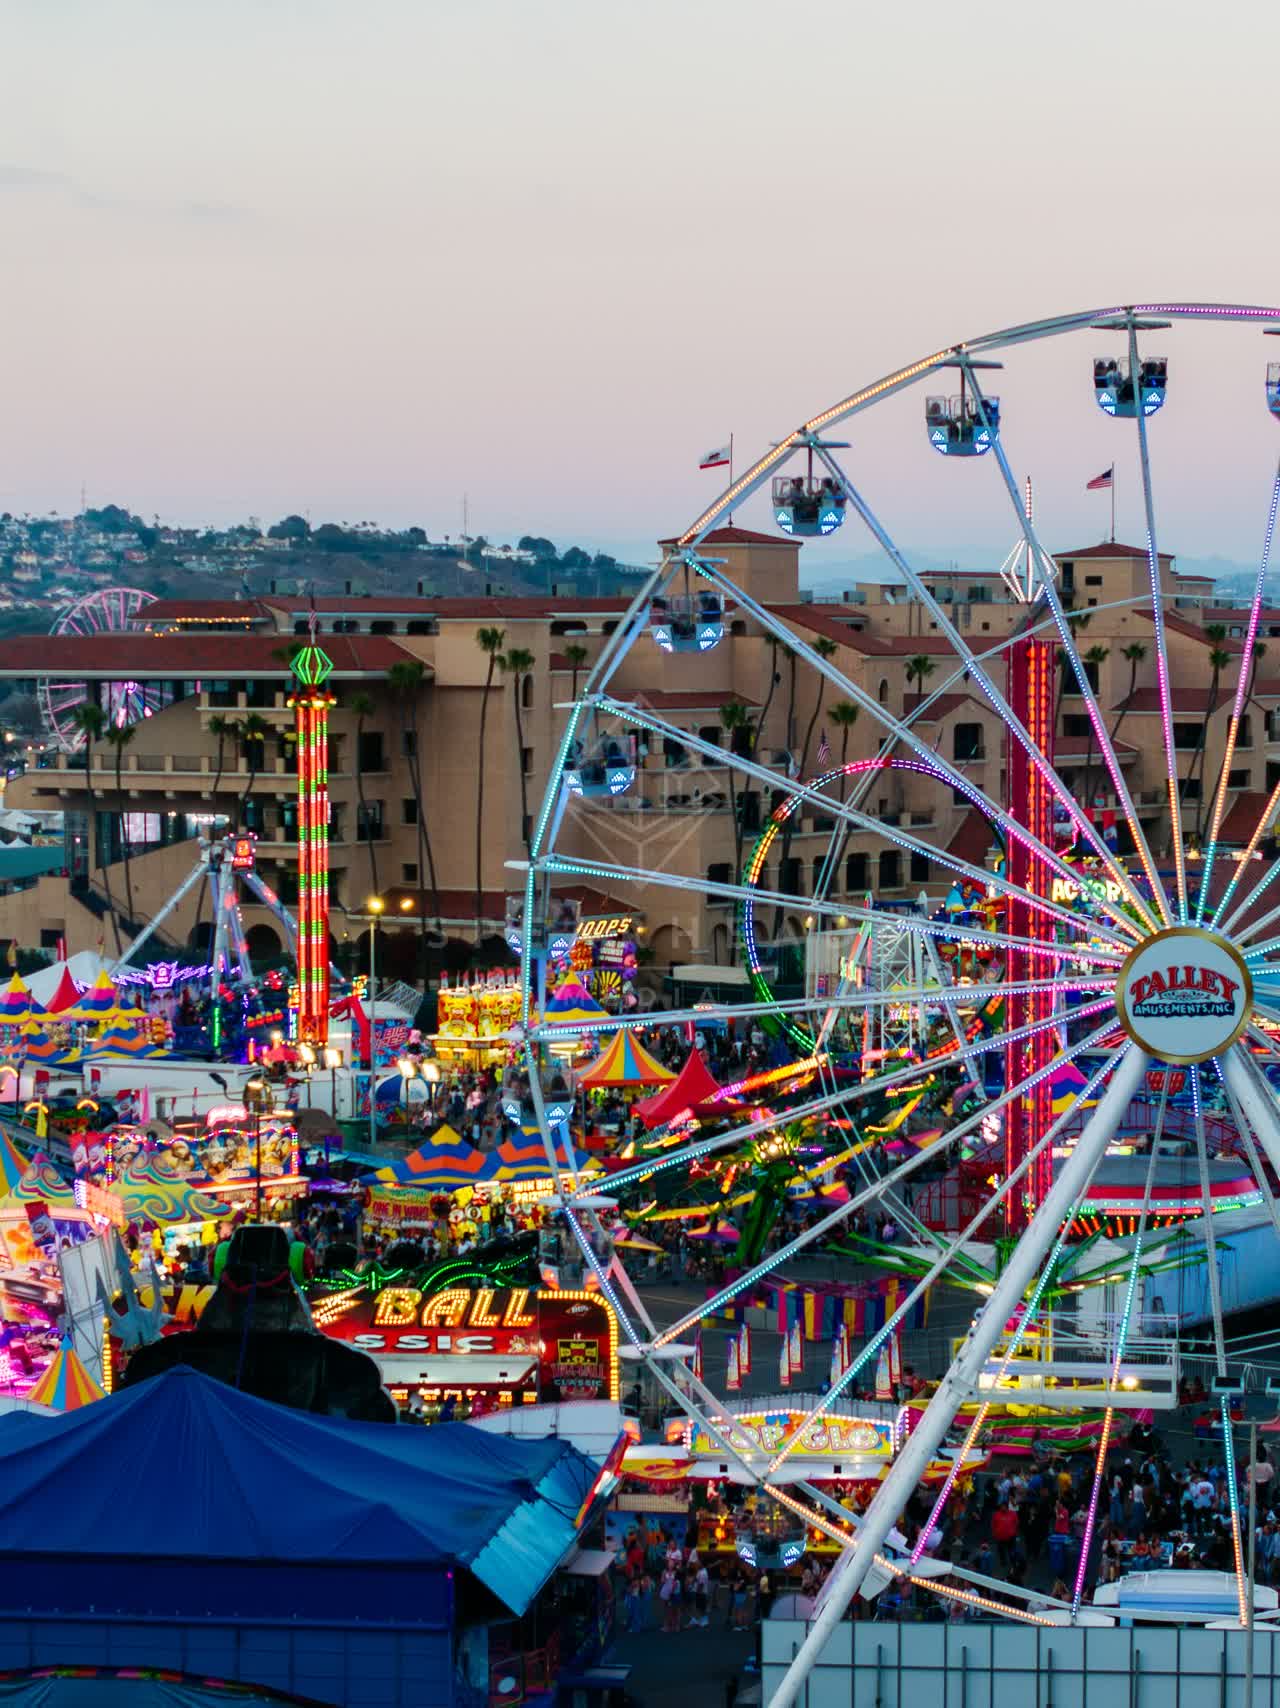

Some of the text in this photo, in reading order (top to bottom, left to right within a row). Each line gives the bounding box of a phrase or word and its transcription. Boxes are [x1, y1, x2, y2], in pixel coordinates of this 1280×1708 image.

[1130, 966, 1239, 1005] TALLEY
[513, 1178, 554, 1192] WIN BIG
[374, 1288, 536, 1327] BALL
[352, 1334, 494, 1350] SSIC
[800, 1424, 881, 1451] GLO
